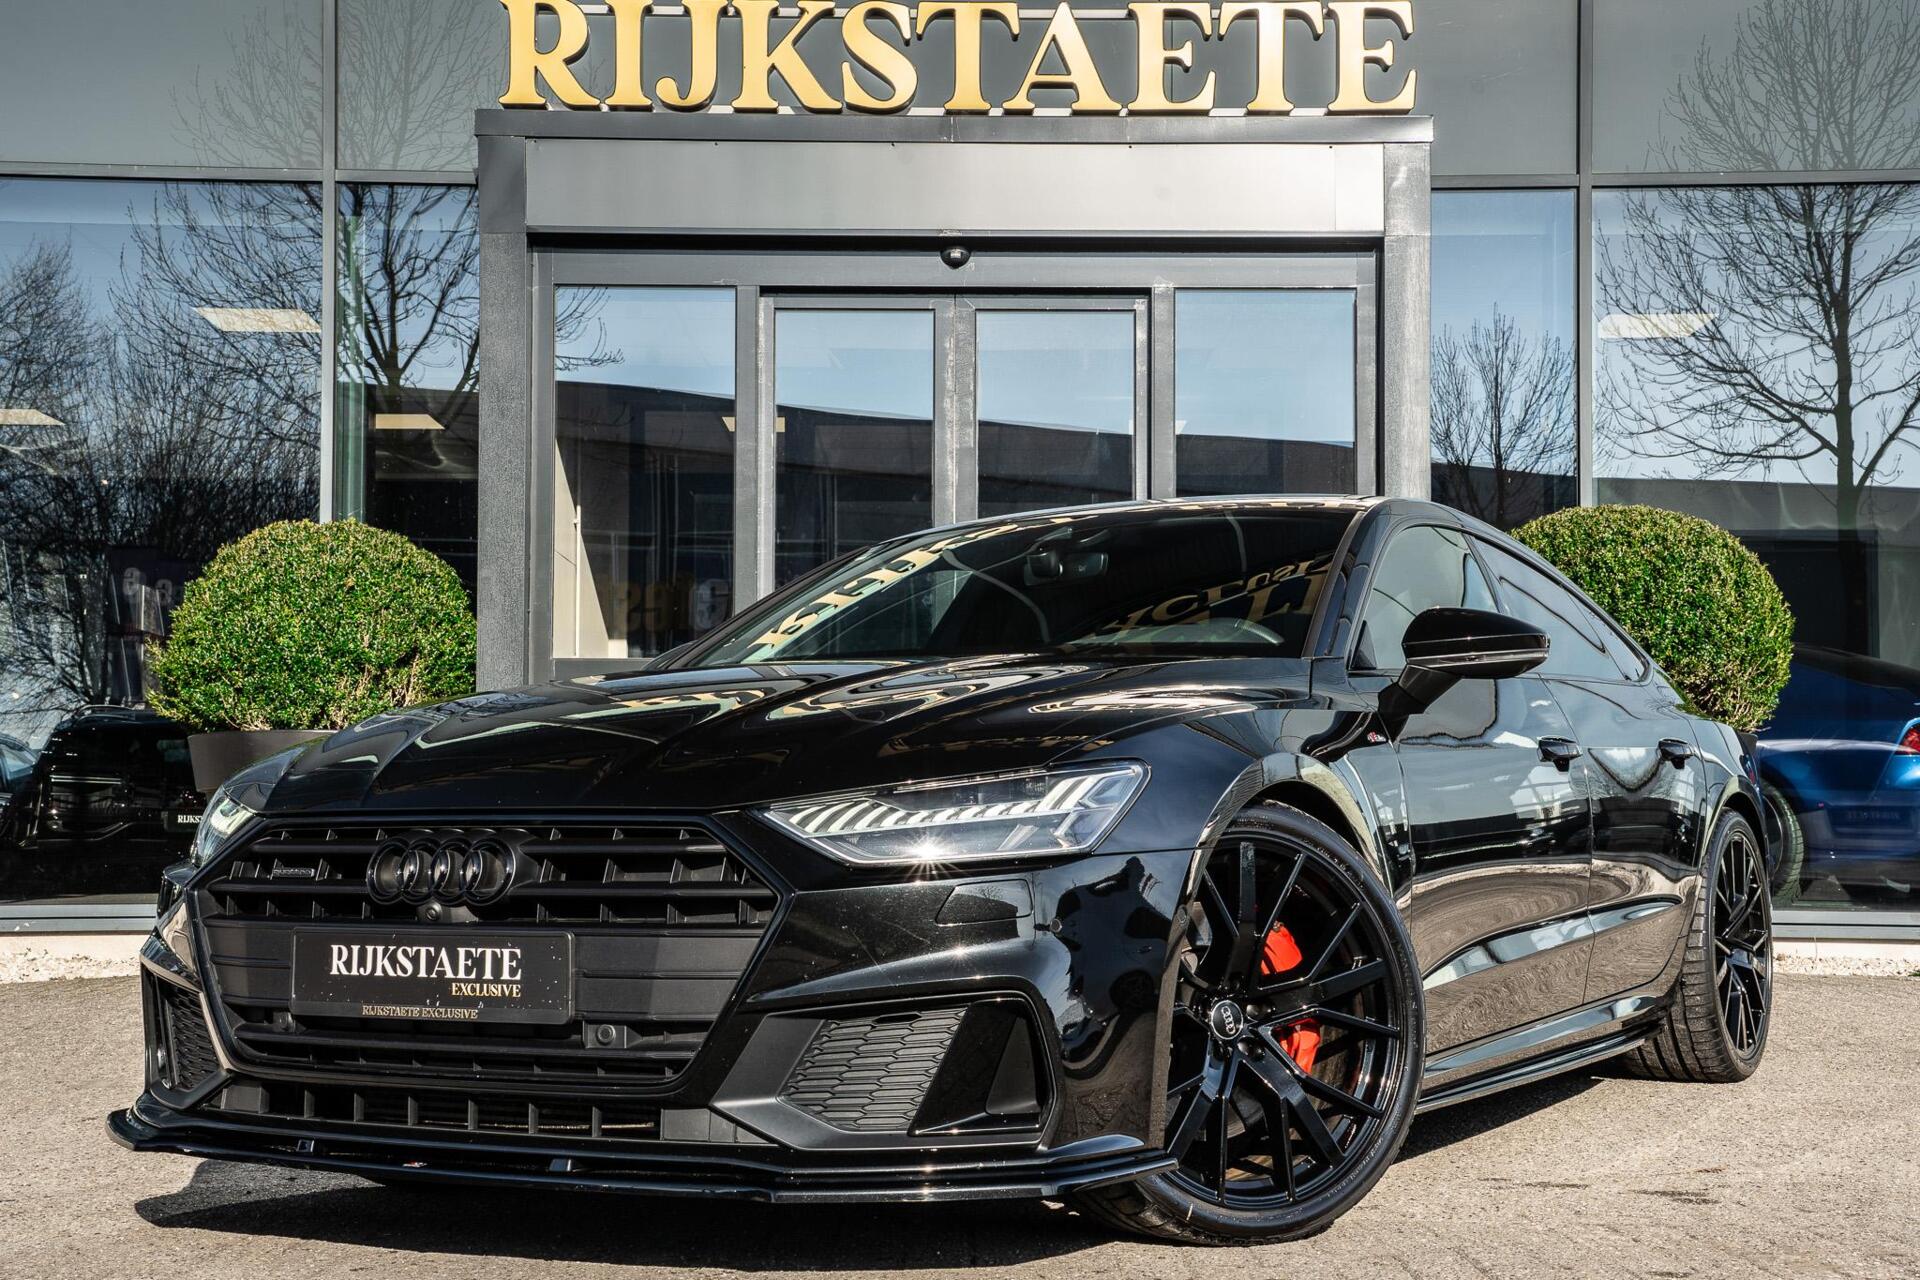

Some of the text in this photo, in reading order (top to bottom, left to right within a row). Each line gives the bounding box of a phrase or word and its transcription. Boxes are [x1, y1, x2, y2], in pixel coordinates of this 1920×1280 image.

[498, 0, 1416, 114] RIJKSTAETE
[329, 944, 522, 980] RIJKSTAETE
[451, 982, 521, 998] EXCLUSIVE
[361, 1004, 479, 1019] RIJKSTAETE EXCLUSIVE
